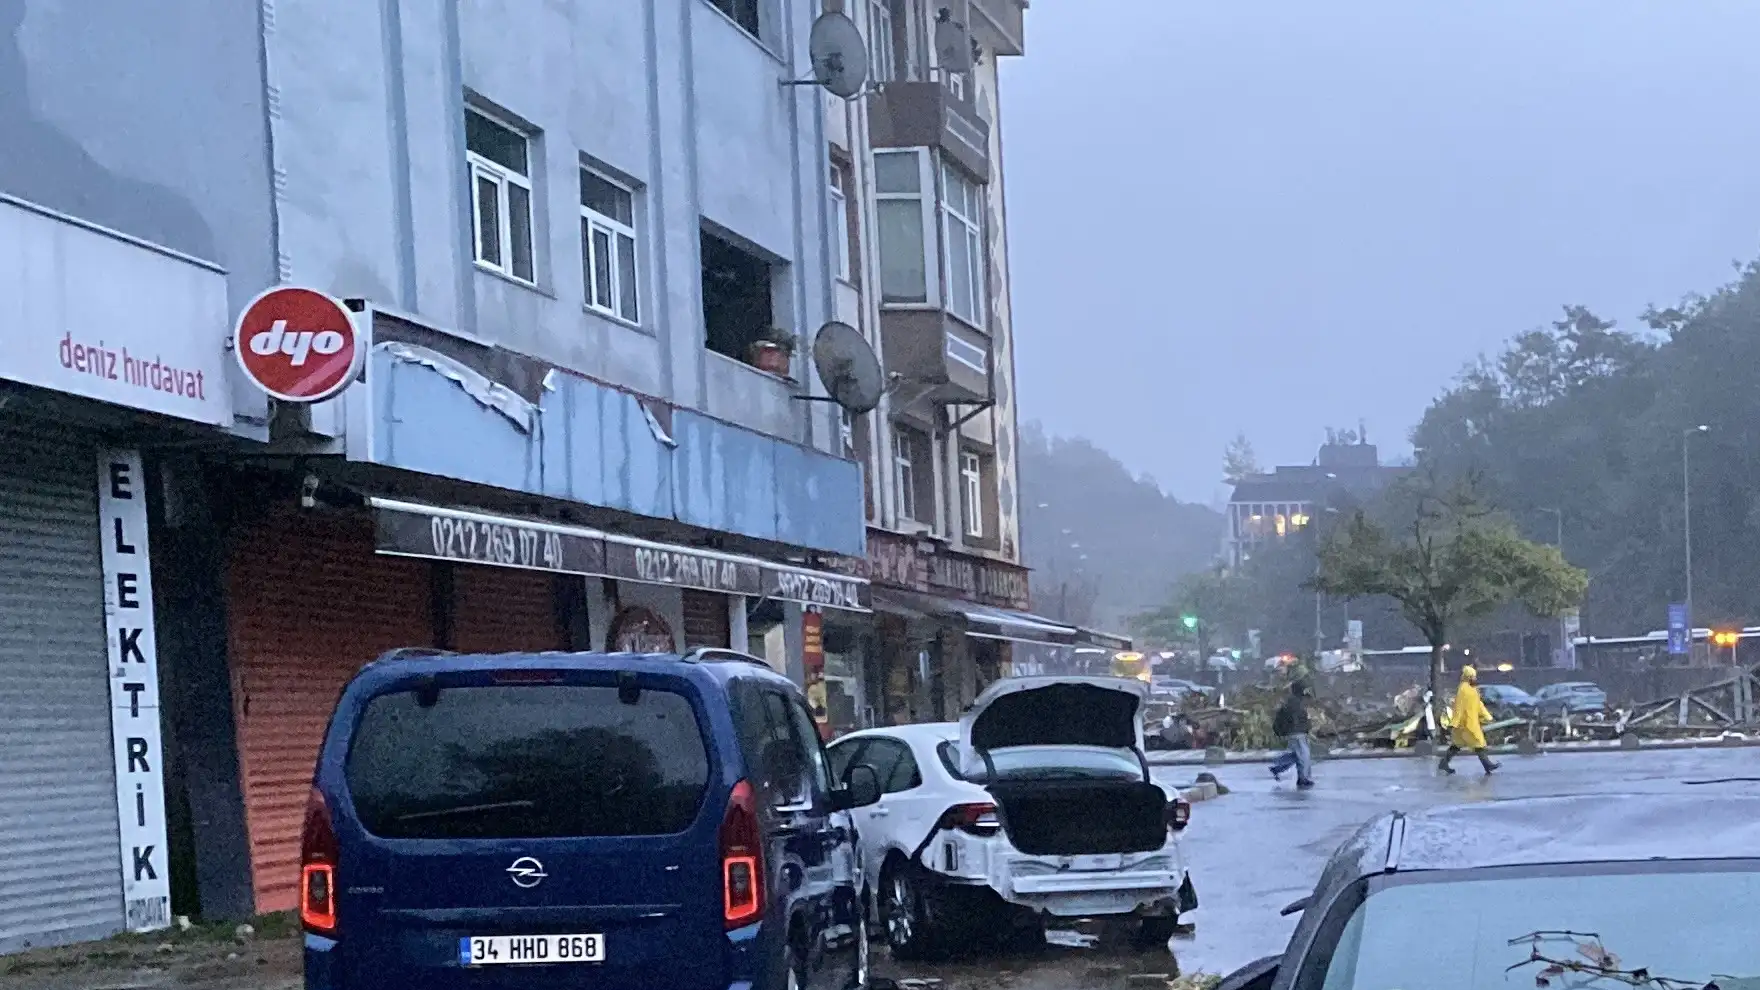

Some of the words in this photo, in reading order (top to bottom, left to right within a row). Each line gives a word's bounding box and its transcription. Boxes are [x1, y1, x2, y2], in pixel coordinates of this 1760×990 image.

[59, 331, 118, 381] deniz
[122, 346, 205, 400] hırdavat
[249, 320, 344, 367] dyo
[432, 516, 477, 560] 0212
[481, 523, 515, 564] 269
[518, 528, 538, 567] 07
[543, 532, 563, 569] 40
[635, 547, 673, 582] 0212
[673, 553, 700, 586] 269
[702, 558, 717, 588] 07
[721, 561, 737, 589] 40
[473, 939, 499, 960] 34
[509, 938, 548, 960] HHD
[558, 937, 596, 959] 868
